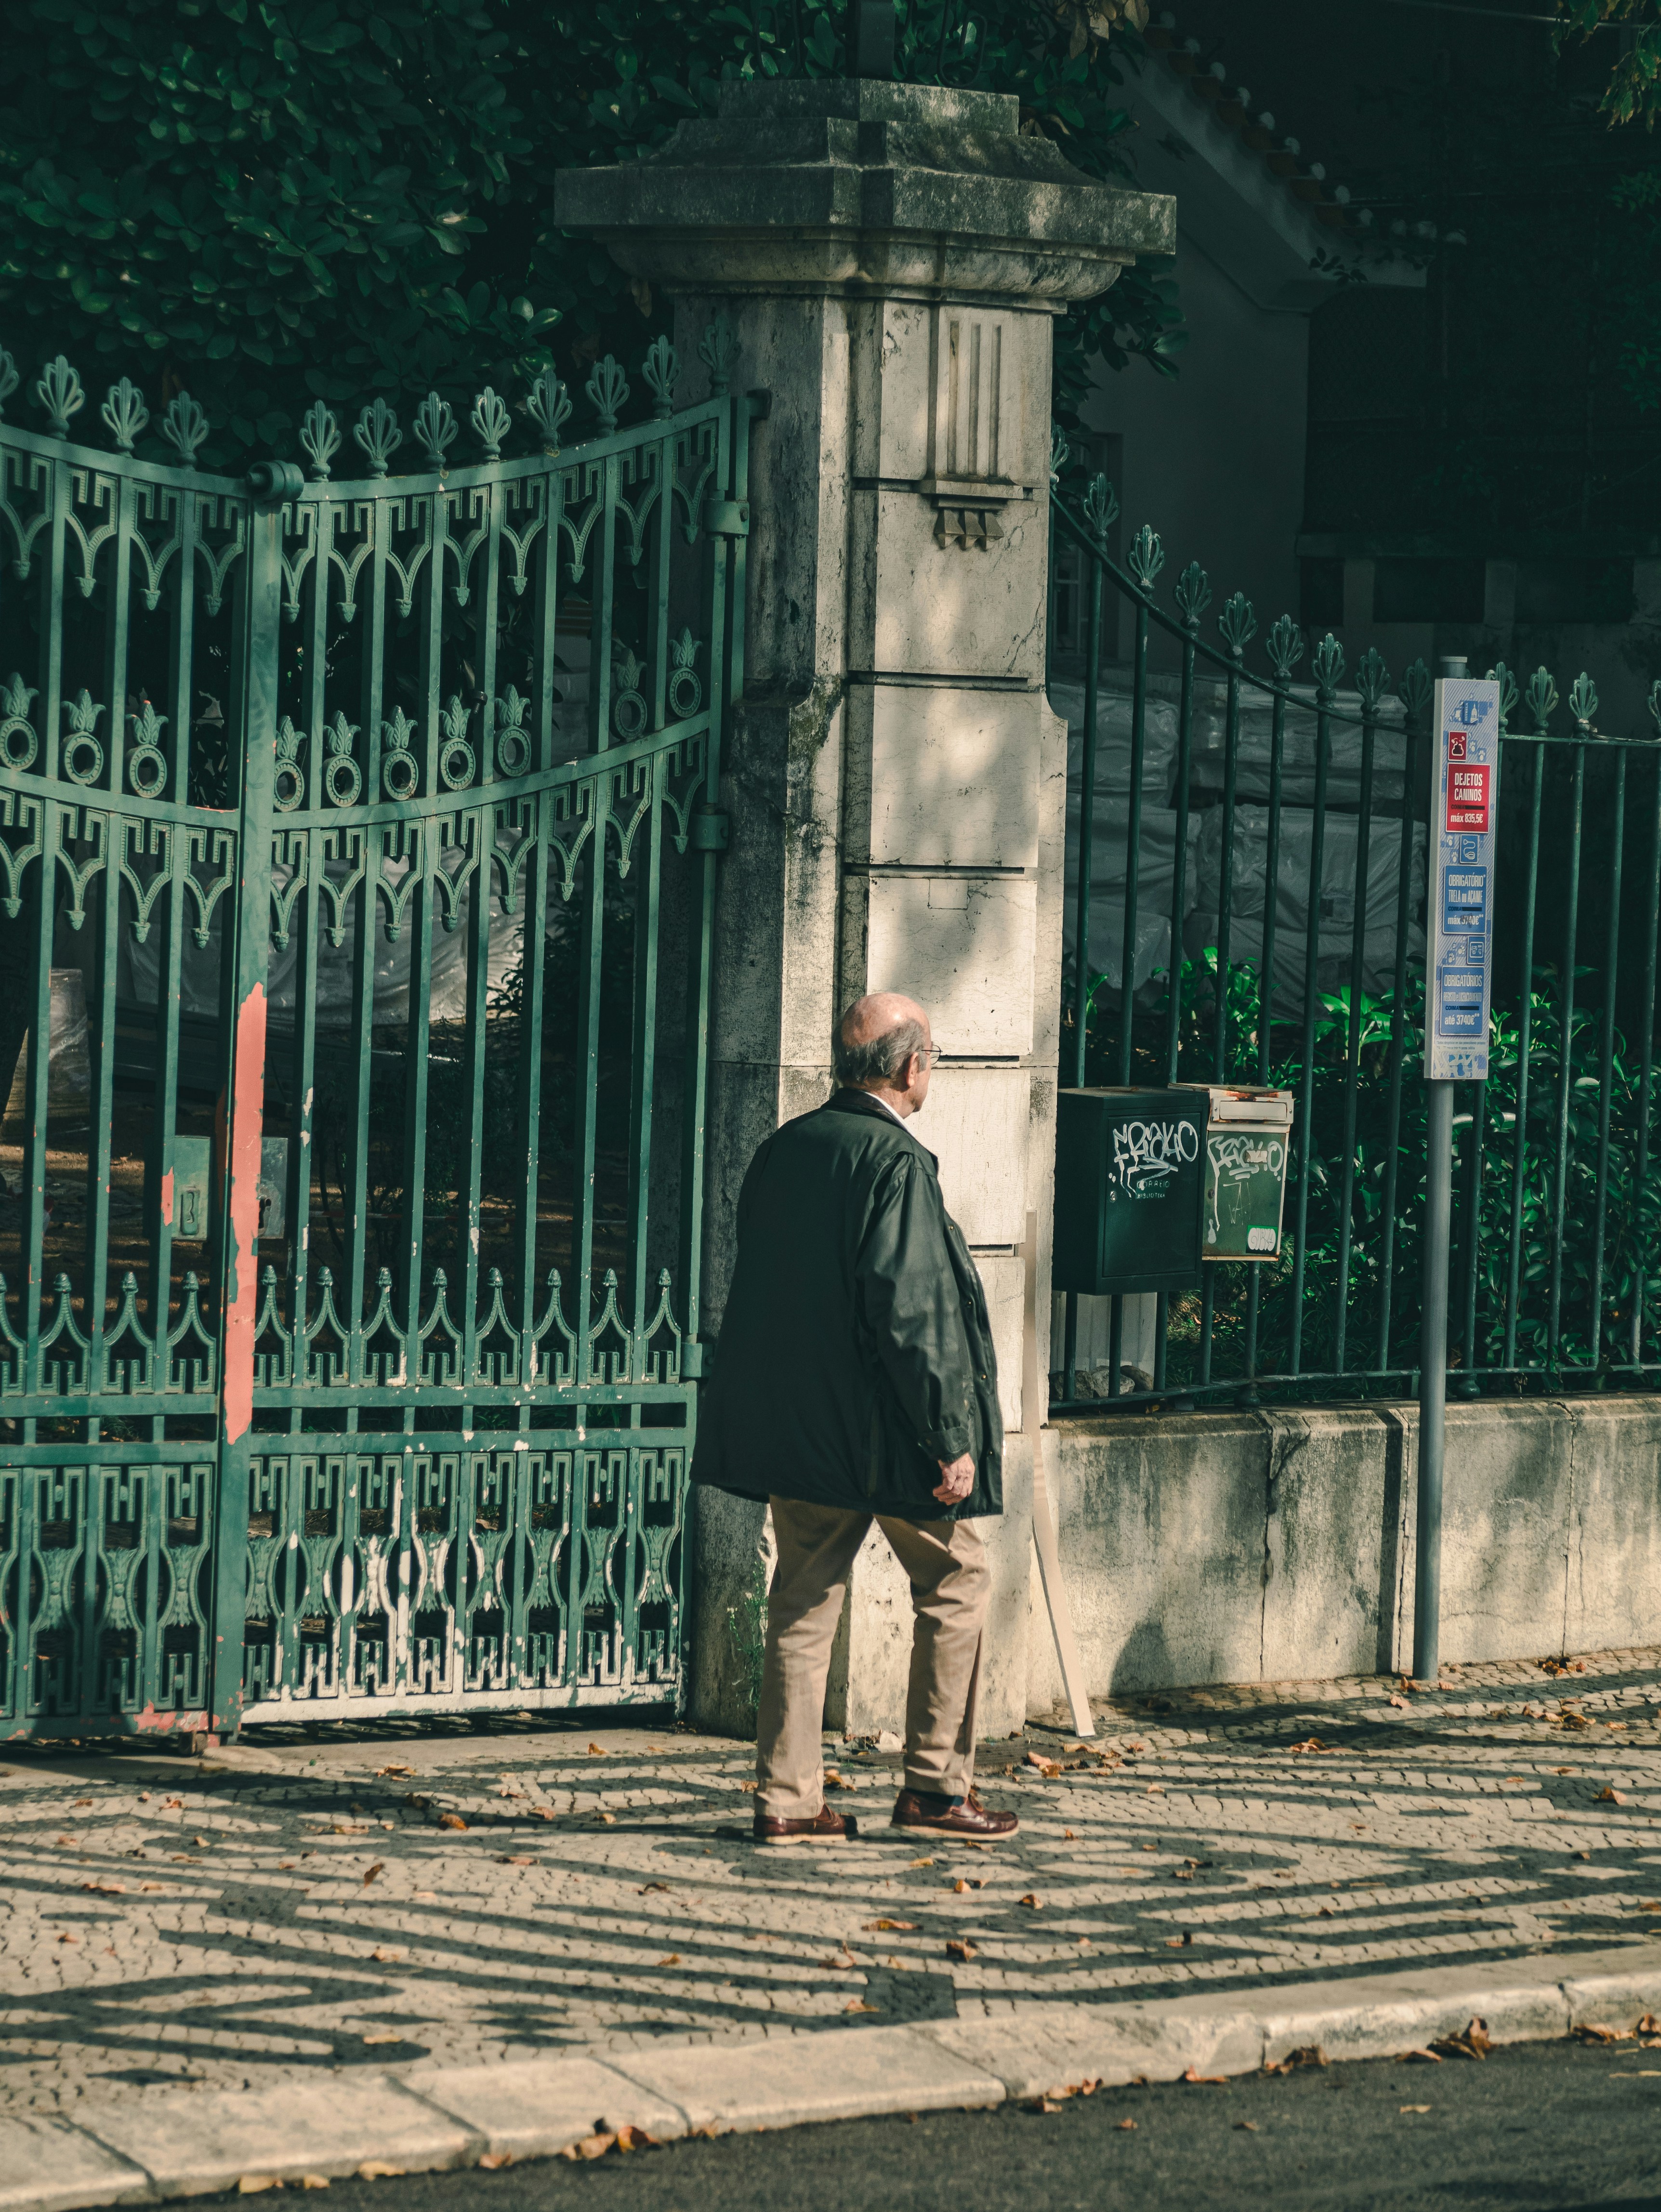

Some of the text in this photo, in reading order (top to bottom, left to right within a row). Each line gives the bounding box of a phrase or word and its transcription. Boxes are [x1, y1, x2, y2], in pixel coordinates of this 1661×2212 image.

[1454, 773, 1483, 787] DEJETOS
[1454, 788, 1482, 802] CANINOS
[1450, 813, 1483, 824] máx 835,5€
[1449, 889, 1483, 905] TRELA ou AÇAIME
[1448, 915, 1461, 925] máx
[1444, 972, 1482, 987] OBRIGATÓRIOS
[1445, 1014, 1455, 1025] até
